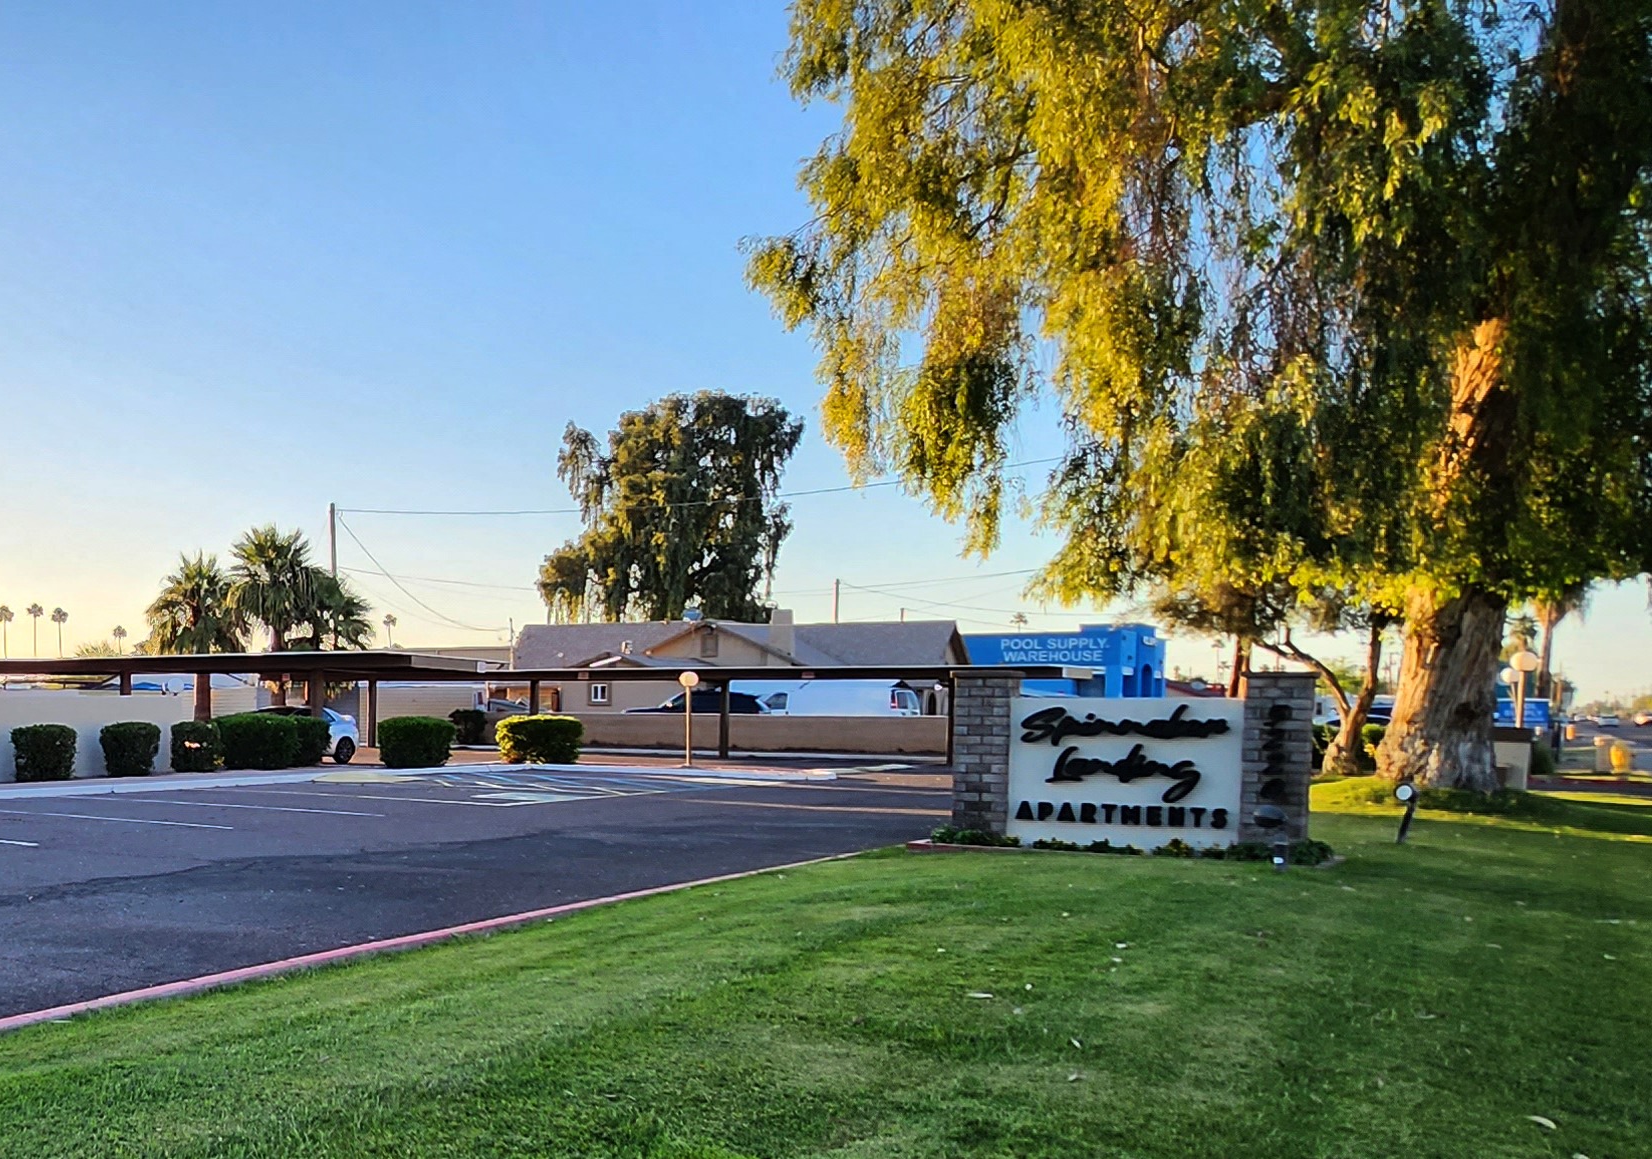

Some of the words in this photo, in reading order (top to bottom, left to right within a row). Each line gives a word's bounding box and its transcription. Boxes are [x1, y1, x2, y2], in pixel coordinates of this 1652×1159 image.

[1000, 638, 1043, 650] POOL
[1003, 650, 1103, 662] WAREHOUSE
[1015, 801, 1228, 829] APARTMENTS
